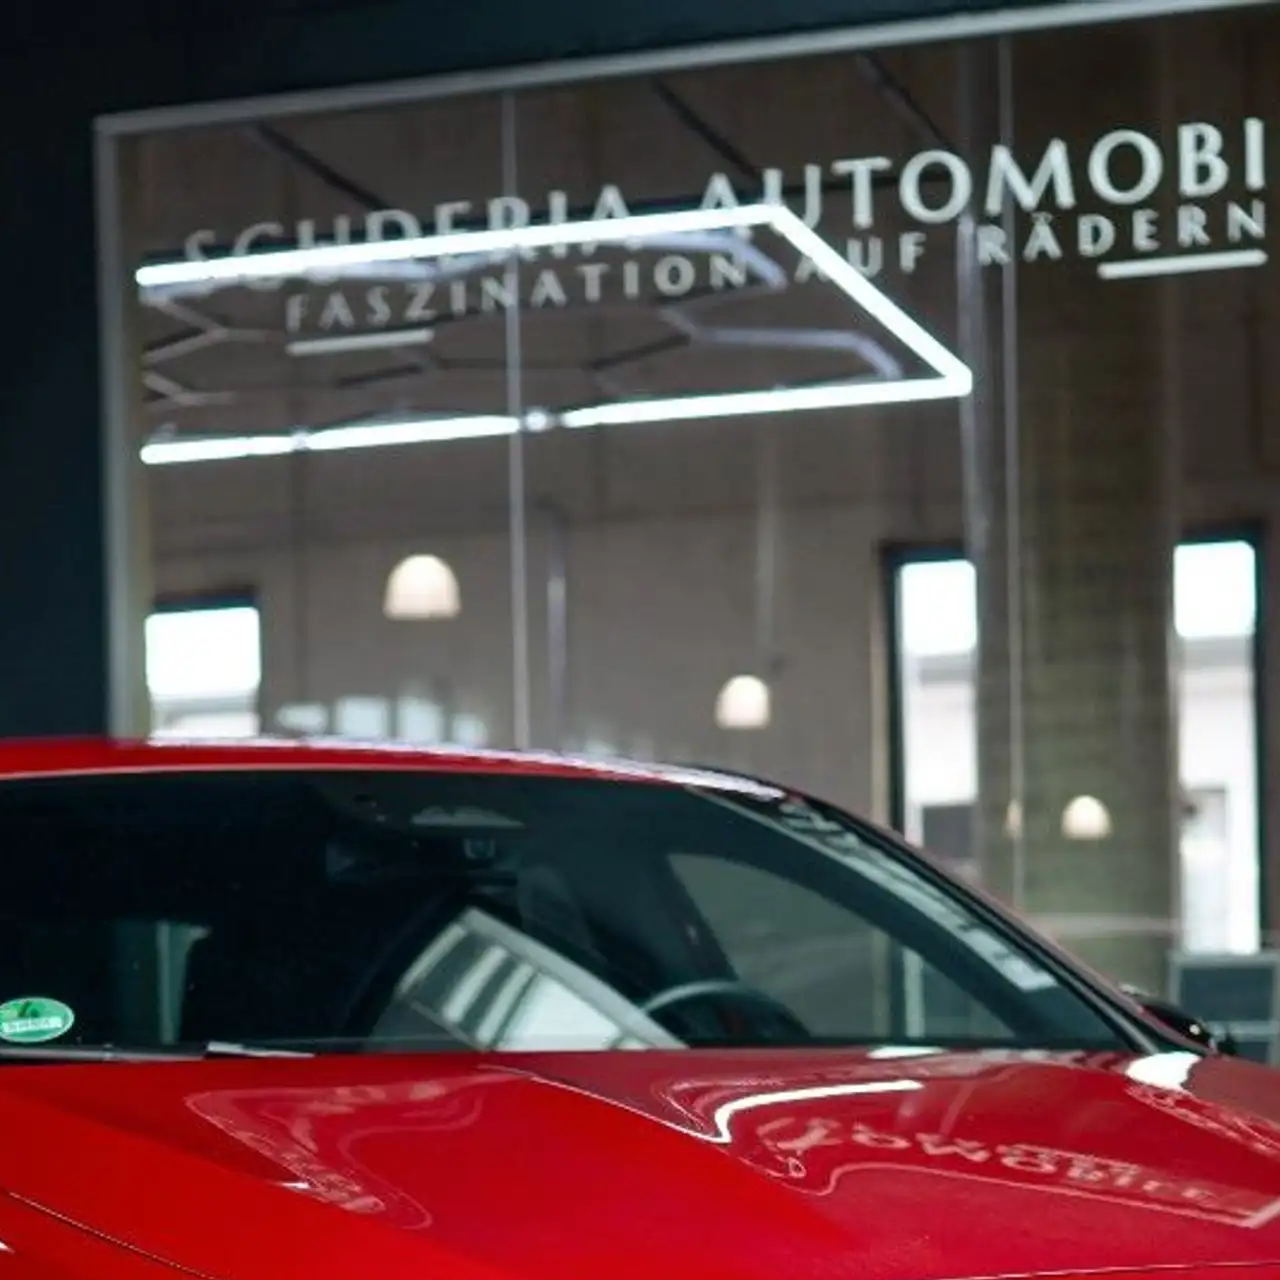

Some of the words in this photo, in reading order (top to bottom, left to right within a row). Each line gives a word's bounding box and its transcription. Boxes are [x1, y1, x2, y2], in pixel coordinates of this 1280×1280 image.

[180, 184, 641, 294] SCUDERIA
[286, 252, 751, 331] FASZINATION
[976, 199, 1269, 266] RÄDERN
